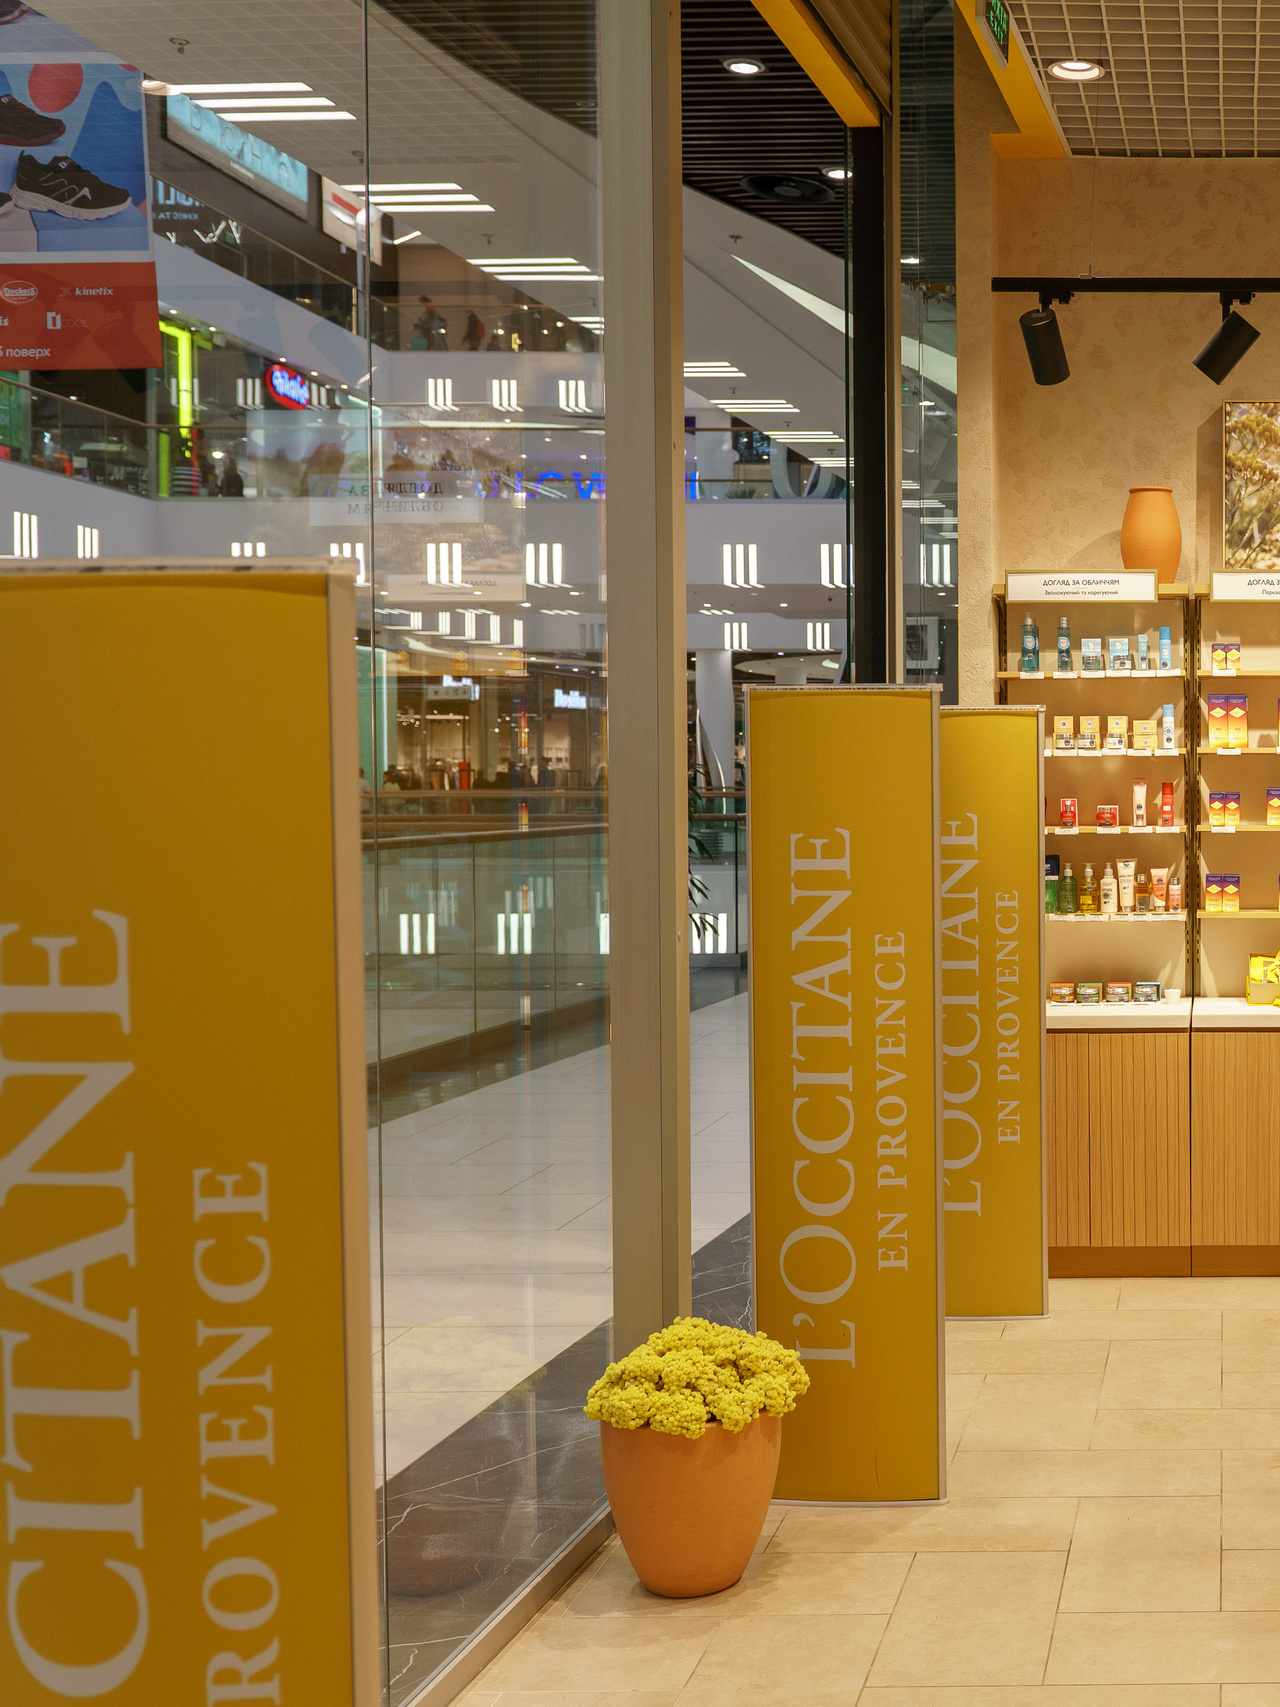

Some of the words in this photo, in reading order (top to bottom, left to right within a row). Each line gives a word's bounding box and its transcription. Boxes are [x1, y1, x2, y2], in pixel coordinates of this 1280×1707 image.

[2, 287, 36, 297] Dockers
[75, 286, 114, 296] kinetix
[6, 347, 51, 359] поверх
[996, 889, 1020, 1089] PROVENCE
[875, 930, 908, 1191] PROVENCE
[779, 827, 858, 1369] L'OCCITANE
[998, 1097, 1021, 1145] EN
[877, 1208, 909, 1272] EN
